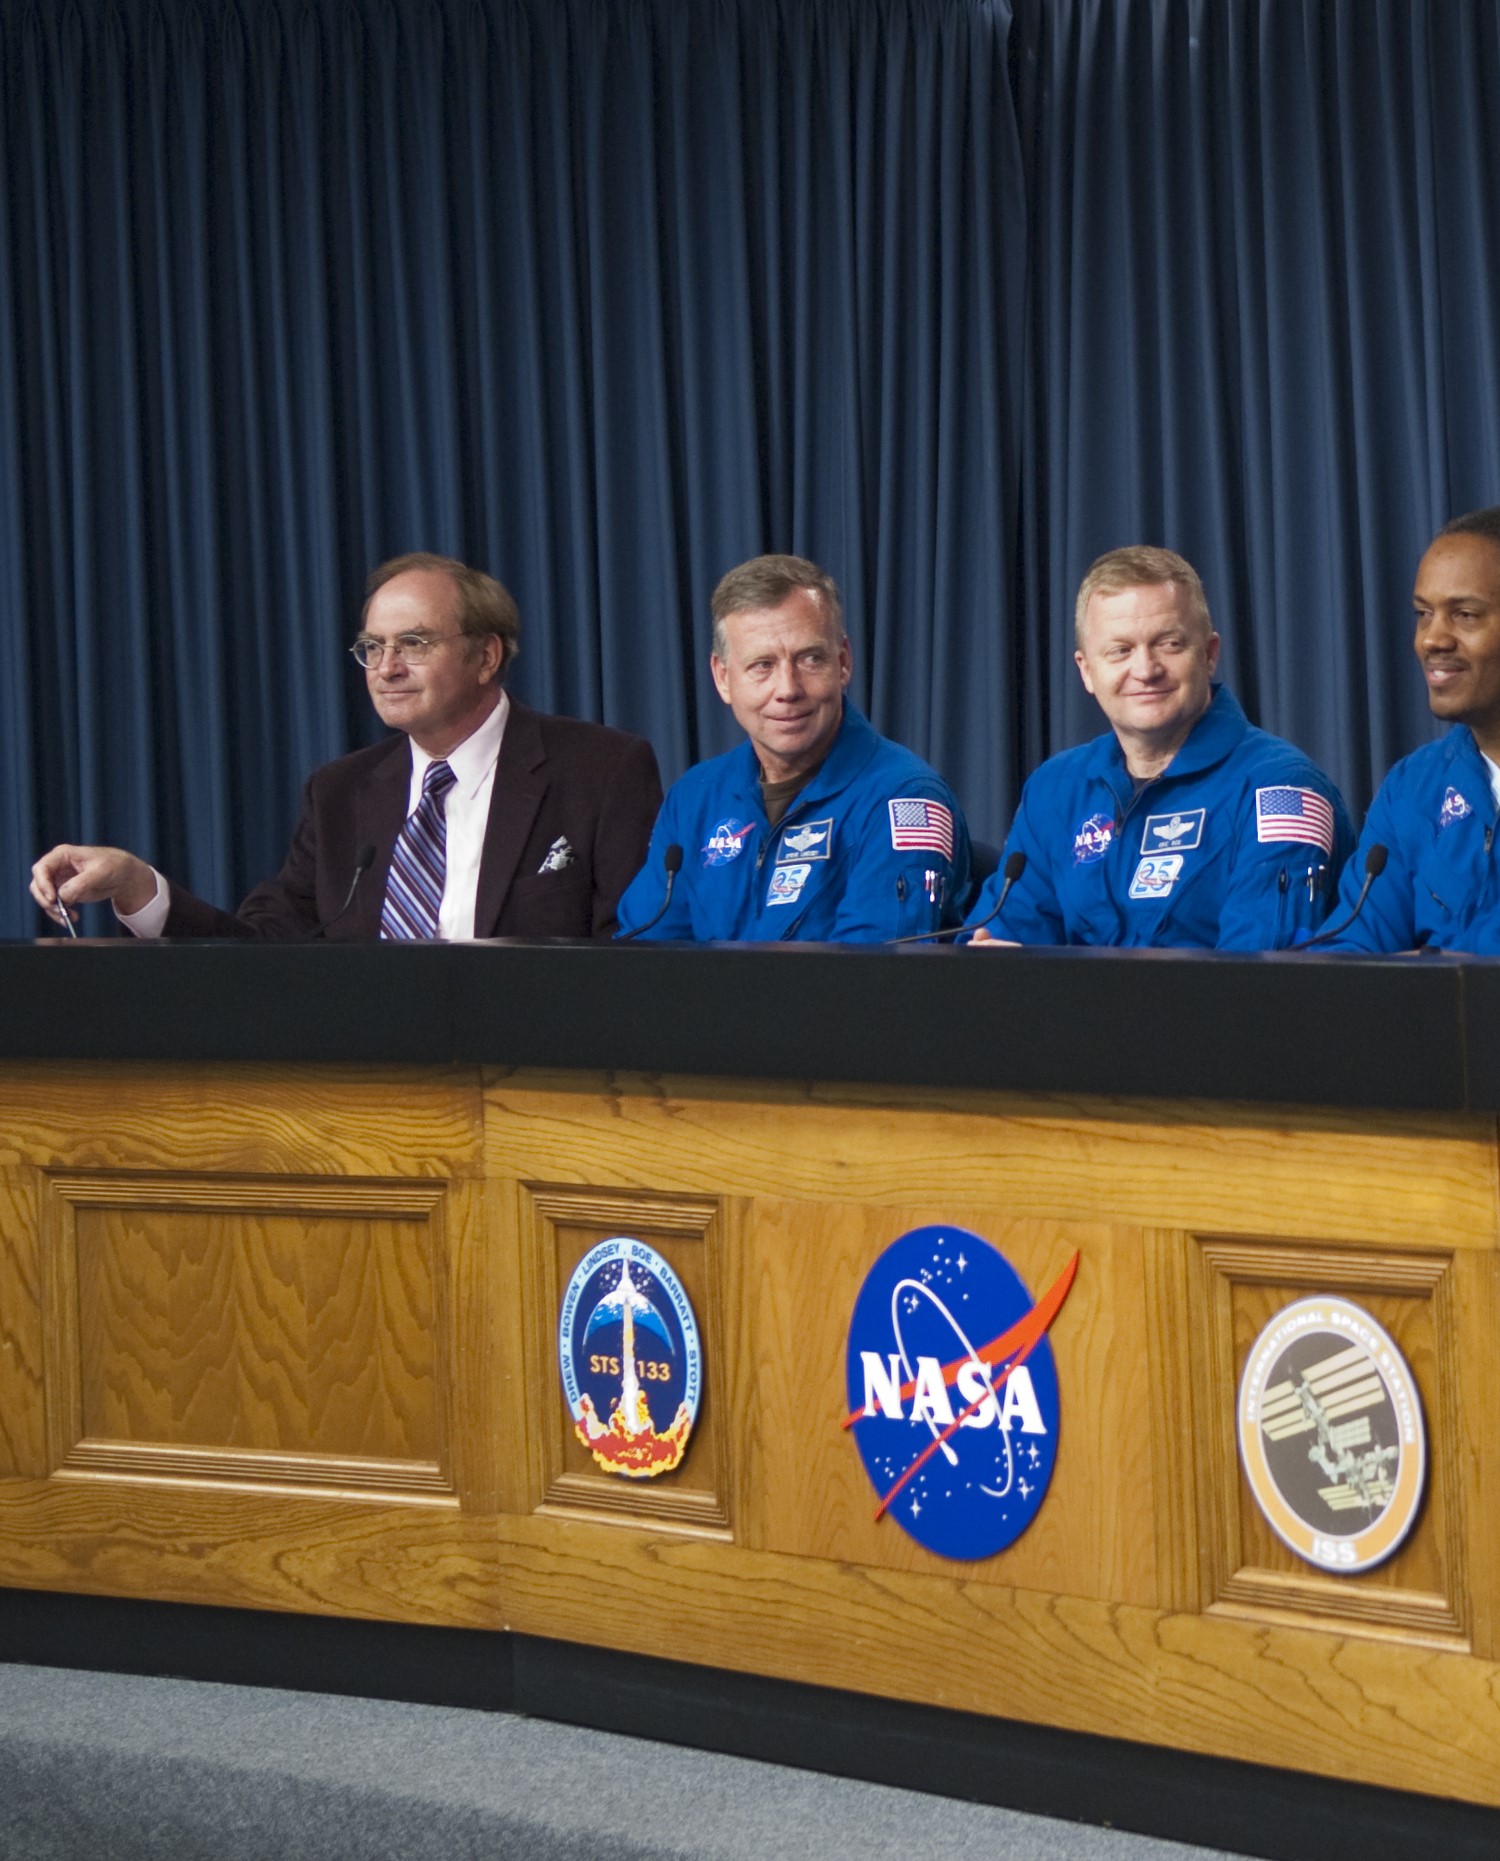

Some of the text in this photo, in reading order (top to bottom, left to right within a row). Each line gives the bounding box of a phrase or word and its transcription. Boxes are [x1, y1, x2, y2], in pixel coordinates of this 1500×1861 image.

[708, 837, 742, 849] NASA
[1075, 829, 1112, 848] NASA
[562, 1243, 697, 1405] DREW BOWEN LINDSEY BOE BARRATT STOTT
[590, 1354, 671, 1382] STS 133
[1247, 1311, 1415, 1444] INTERNATIONAL SPACE STATION
[860, 1350, 1048, 1435] NASA
[1312, 1537, 1357, 1564] ISS
